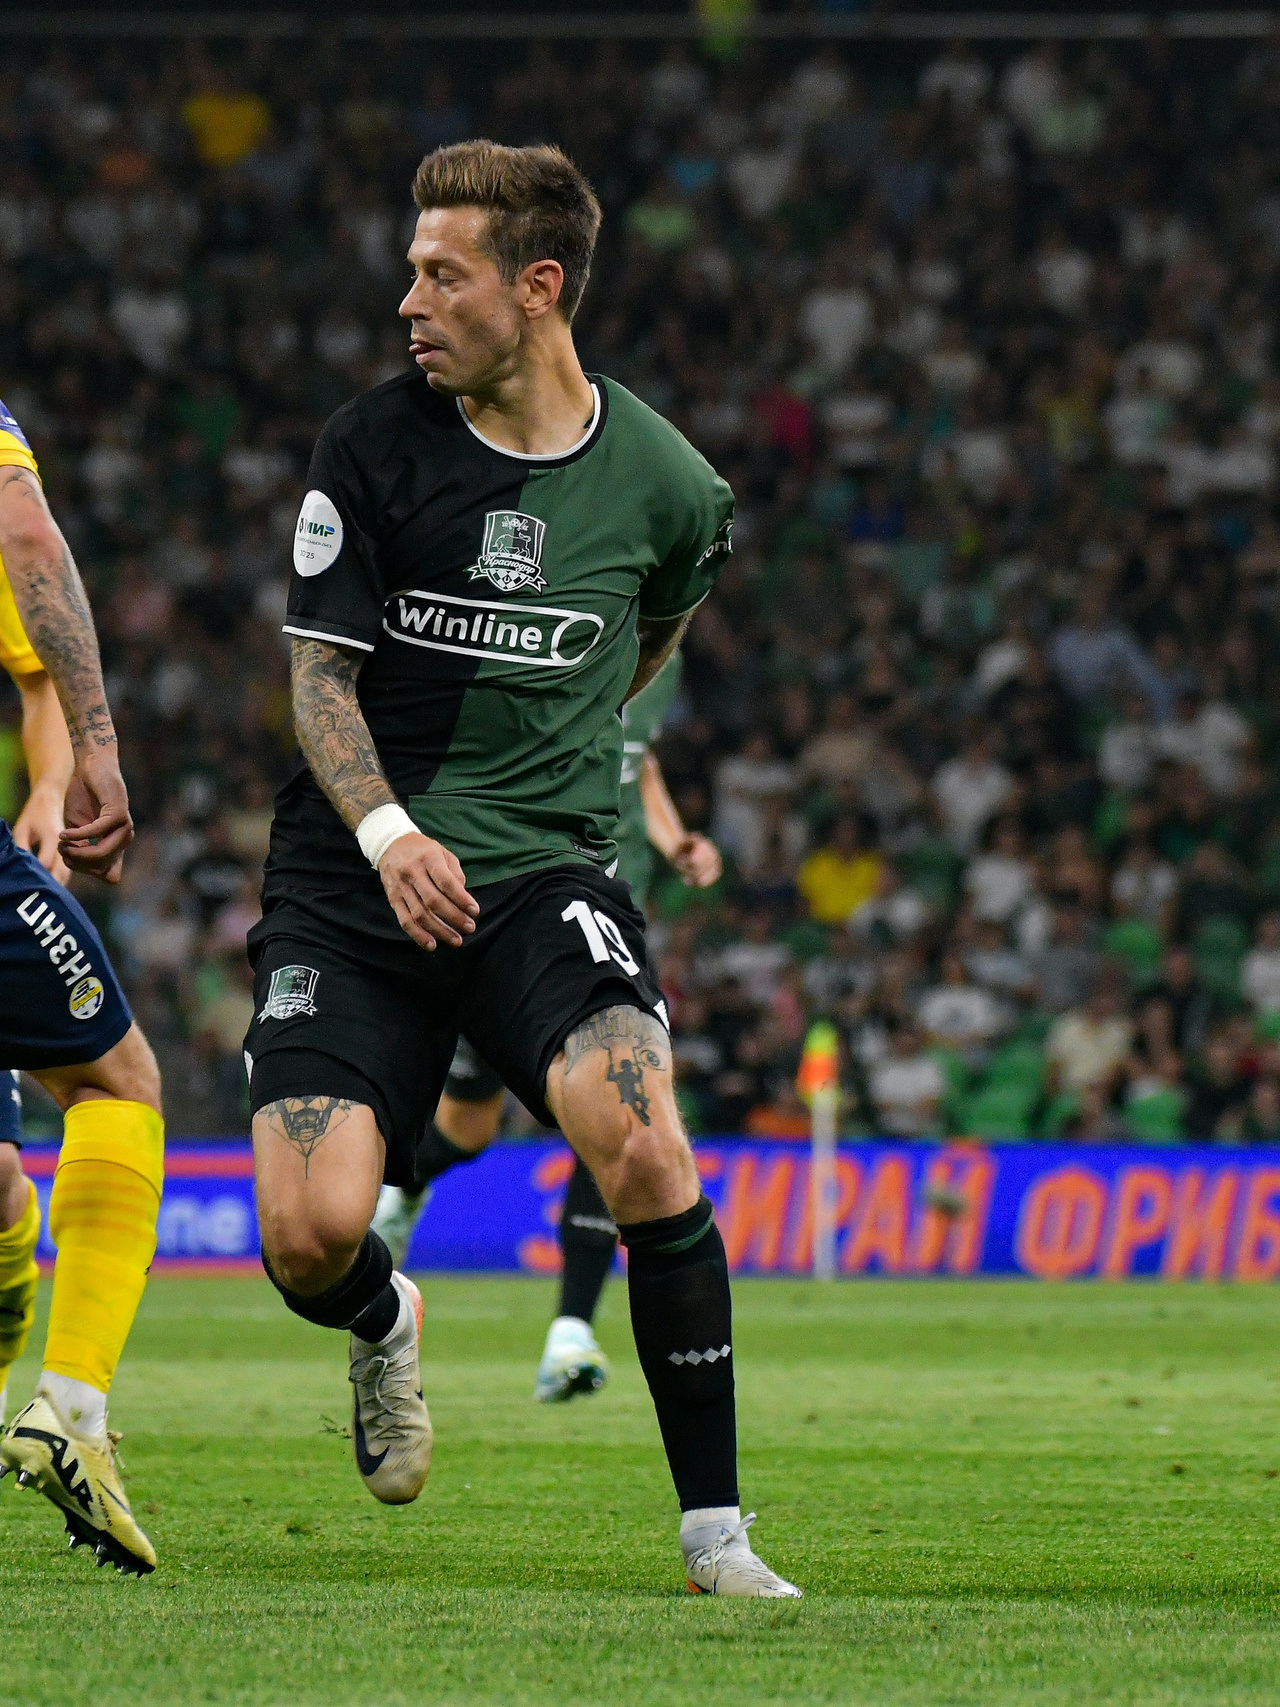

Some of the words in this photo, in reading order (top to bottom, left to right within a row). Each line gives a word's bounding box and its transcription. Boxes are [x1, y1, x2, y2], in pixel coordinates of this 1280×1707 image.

[399, 598, 542, 651] Winline
[16, 891, 93, 987] НЗНП
[561, 900, 640, 977] 19
